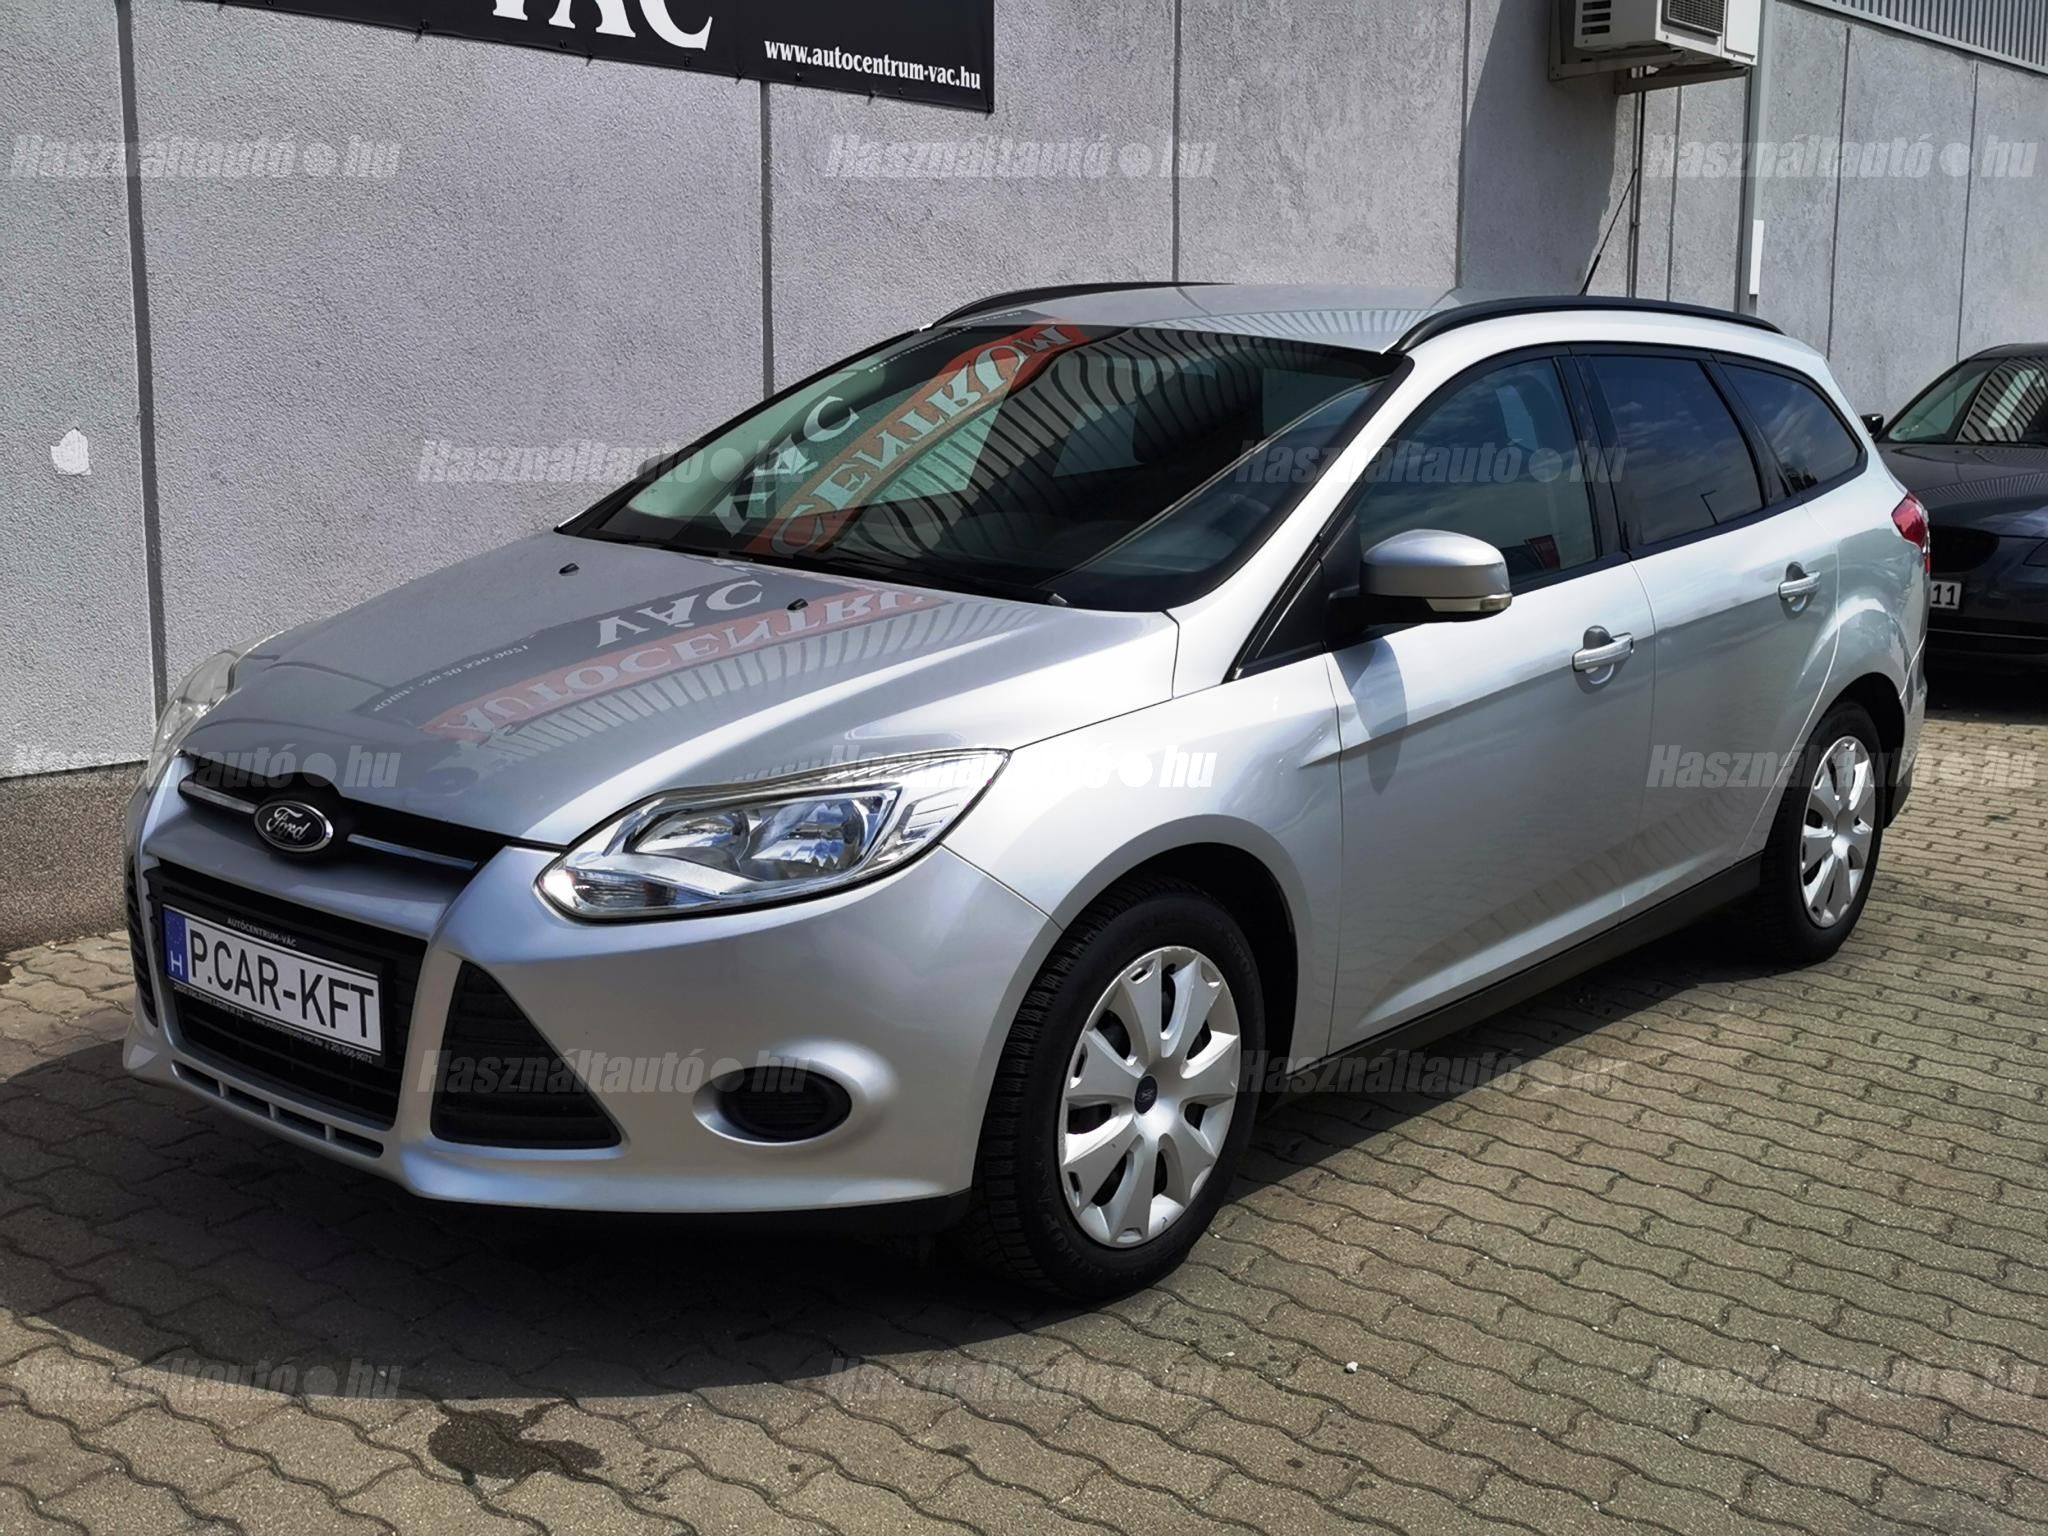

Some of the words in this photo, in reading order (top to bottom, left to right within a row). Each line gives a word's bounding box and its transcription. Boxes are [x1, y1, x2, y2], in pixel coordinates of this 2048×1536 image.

[764, 40, 981, 90] www.autocentrum-vac.hu
[265, 806, 312, 841] Ford
[170, 950, 184, 977] H
[189, 928, 375, 1039] P.CAR-KFT
